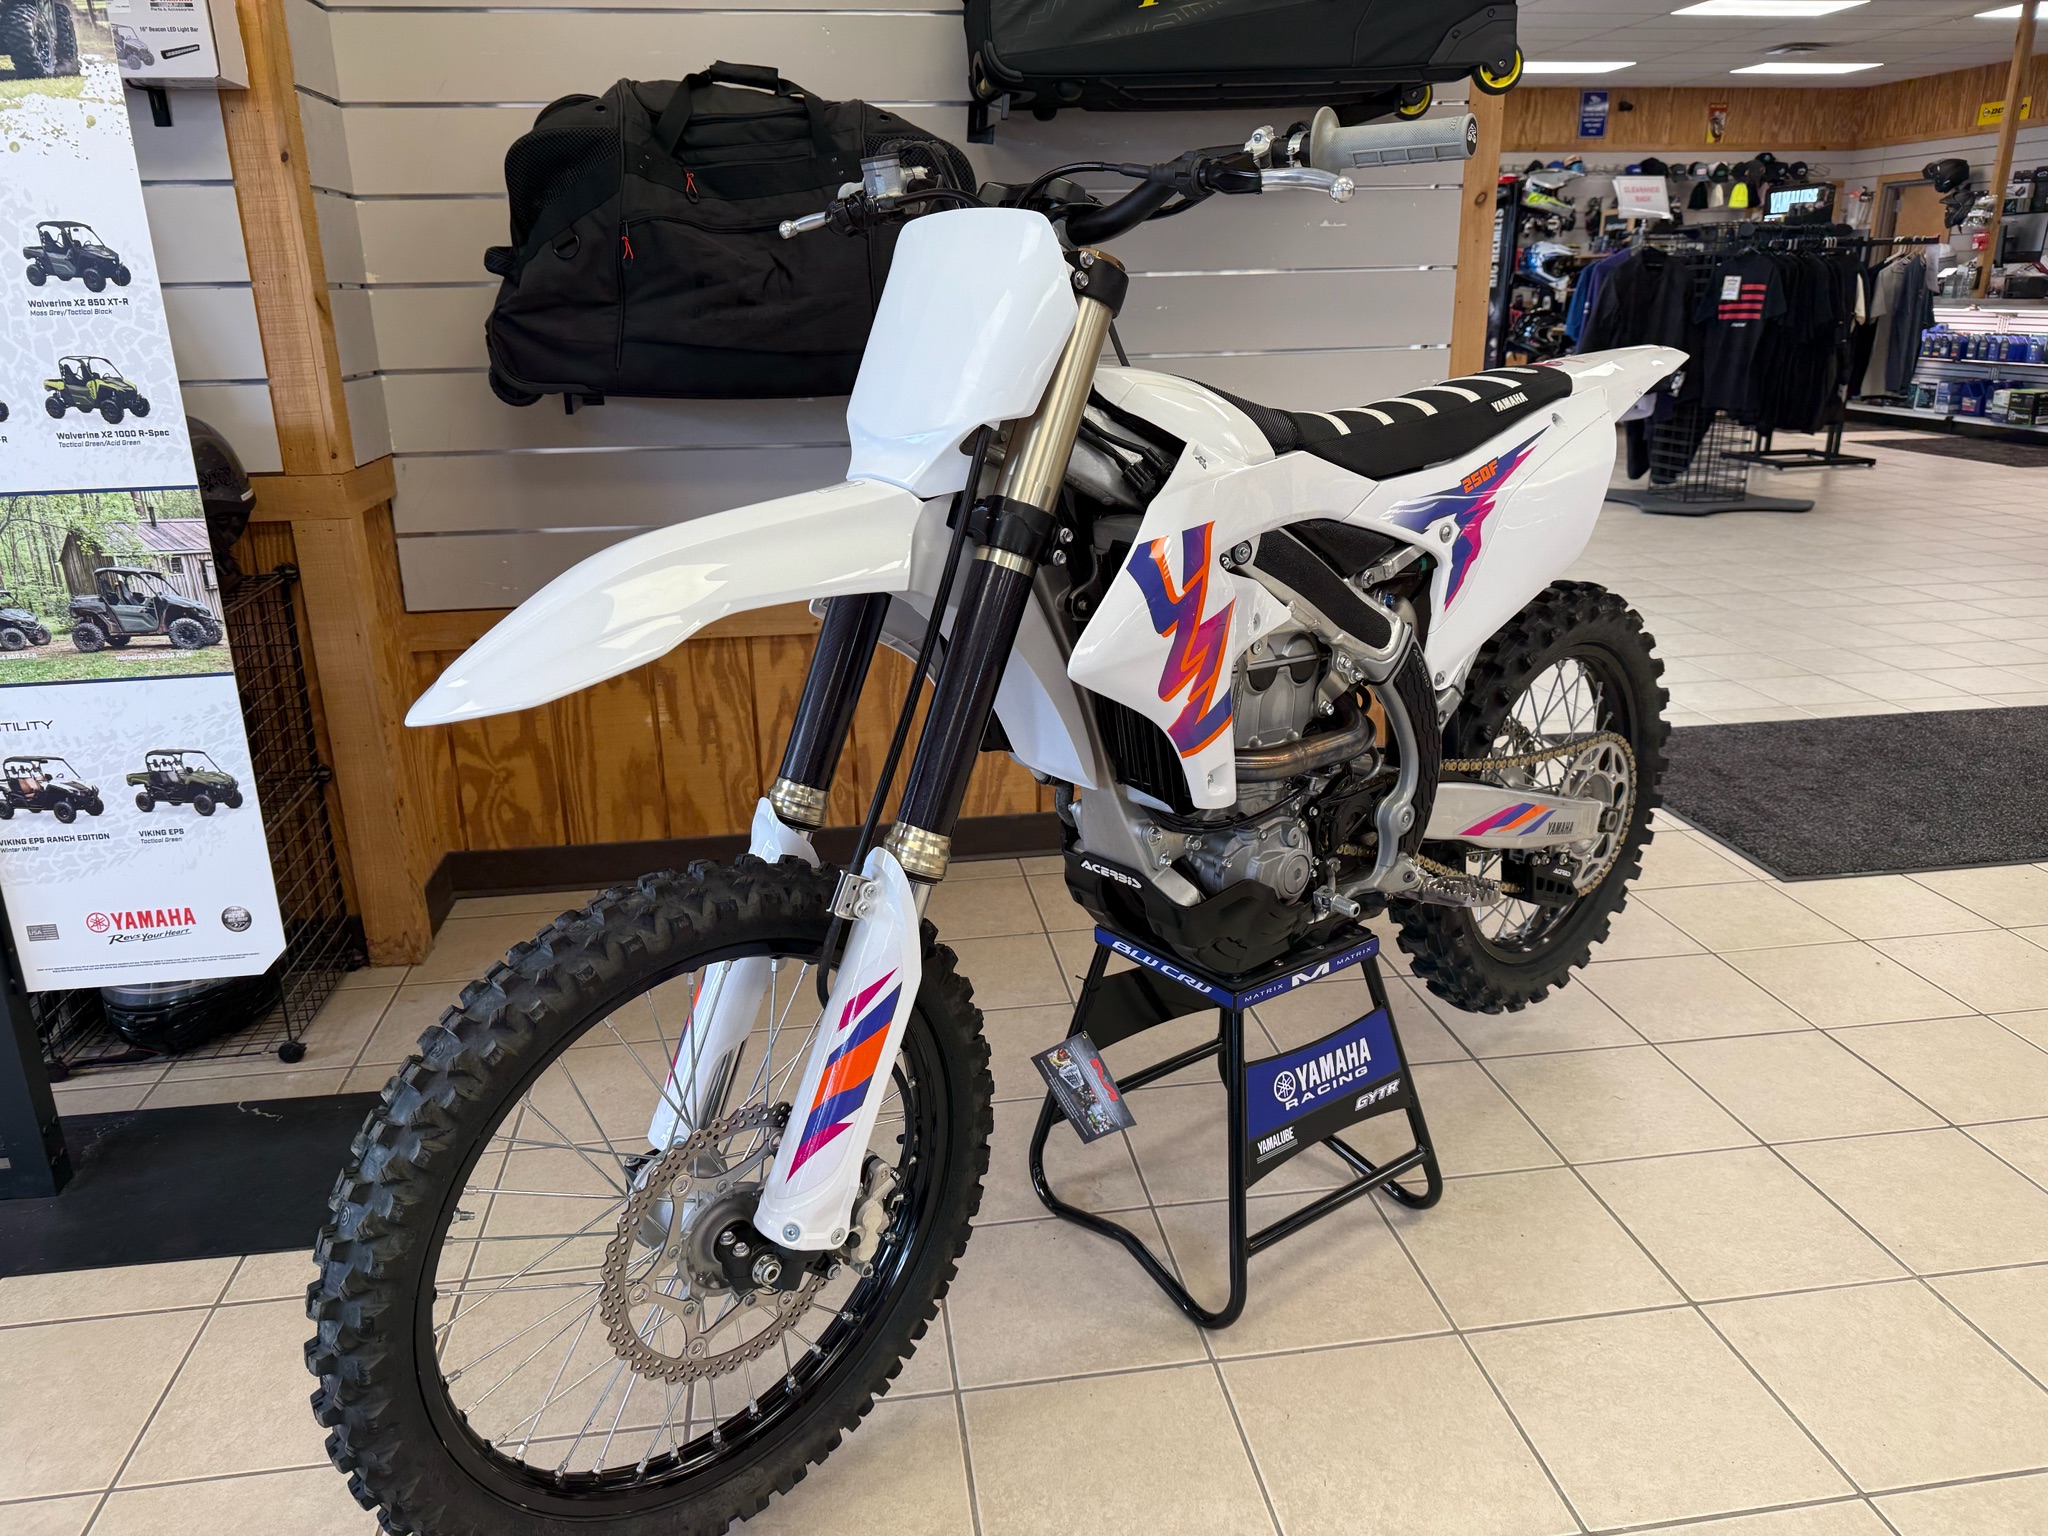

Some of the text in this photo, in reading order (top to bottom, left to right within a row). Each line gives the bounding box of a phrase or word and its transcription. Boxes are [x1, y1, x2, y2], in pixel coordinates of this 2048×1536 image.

[1491, 207, 1505, 262] HELMETS
[28, 298, 129, 308] Wolverine X2 850 XT-R
[1491, 391, 1529, 413] YAMAHA
[56, 429, 170, 440] Wolverine X2 1000 R-Spec
[1461, 459, 1498, 494] 250F
[0, 833, 110, 846] VIKING EPS RANCH EDITION
[138, 828, 185, 837] VIKING EPS
[1547, 821, 1575, 836] YAMAHA
[110, 907, 197, 931] YAMAHA
[1112, 941, 1213, 994] BLU CRU
[1244, 983, 1284, 1003] MATRIX
[1336, 946, 1372, 966] MATRIX
[1295, 1037, 1372, 1092] YAMAHA
[1285, 1066, 1369, 1111] RACING
[1354, 1078, 1401, 1112] GYTR
[1257, 1126, 1296, 1155] YAMALUBE
